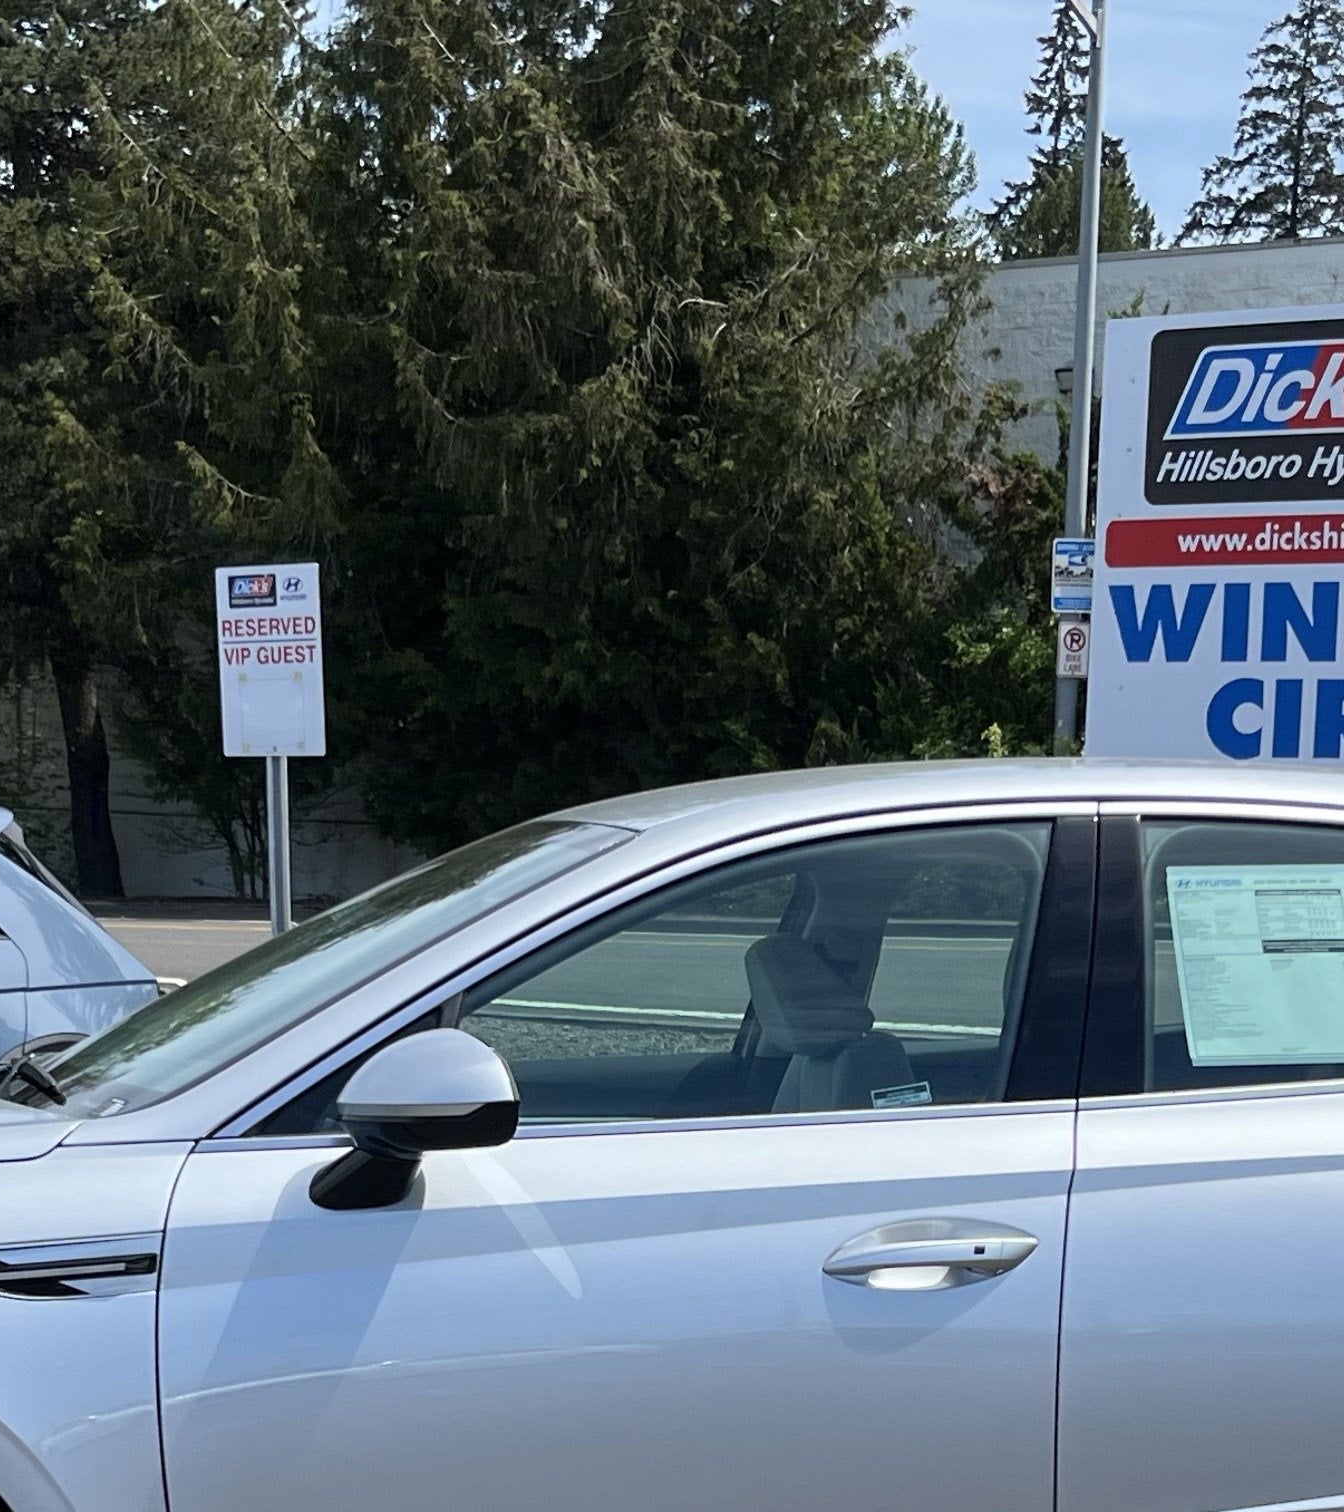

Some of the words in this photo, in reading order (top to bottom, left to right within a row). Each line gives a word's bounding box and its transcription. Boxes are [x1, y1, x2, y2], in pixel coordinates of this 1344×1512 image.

[1156, 449, 1303, 483] Hillsboro
[222, 616, 316, 637] RESERVED
[224, 647, 251, 665] VIP
[257, 645, 316, 665] GUEST
[1065, 654, 1081, 663] BIKE
[1064, 664, 1082, 673] LANE
